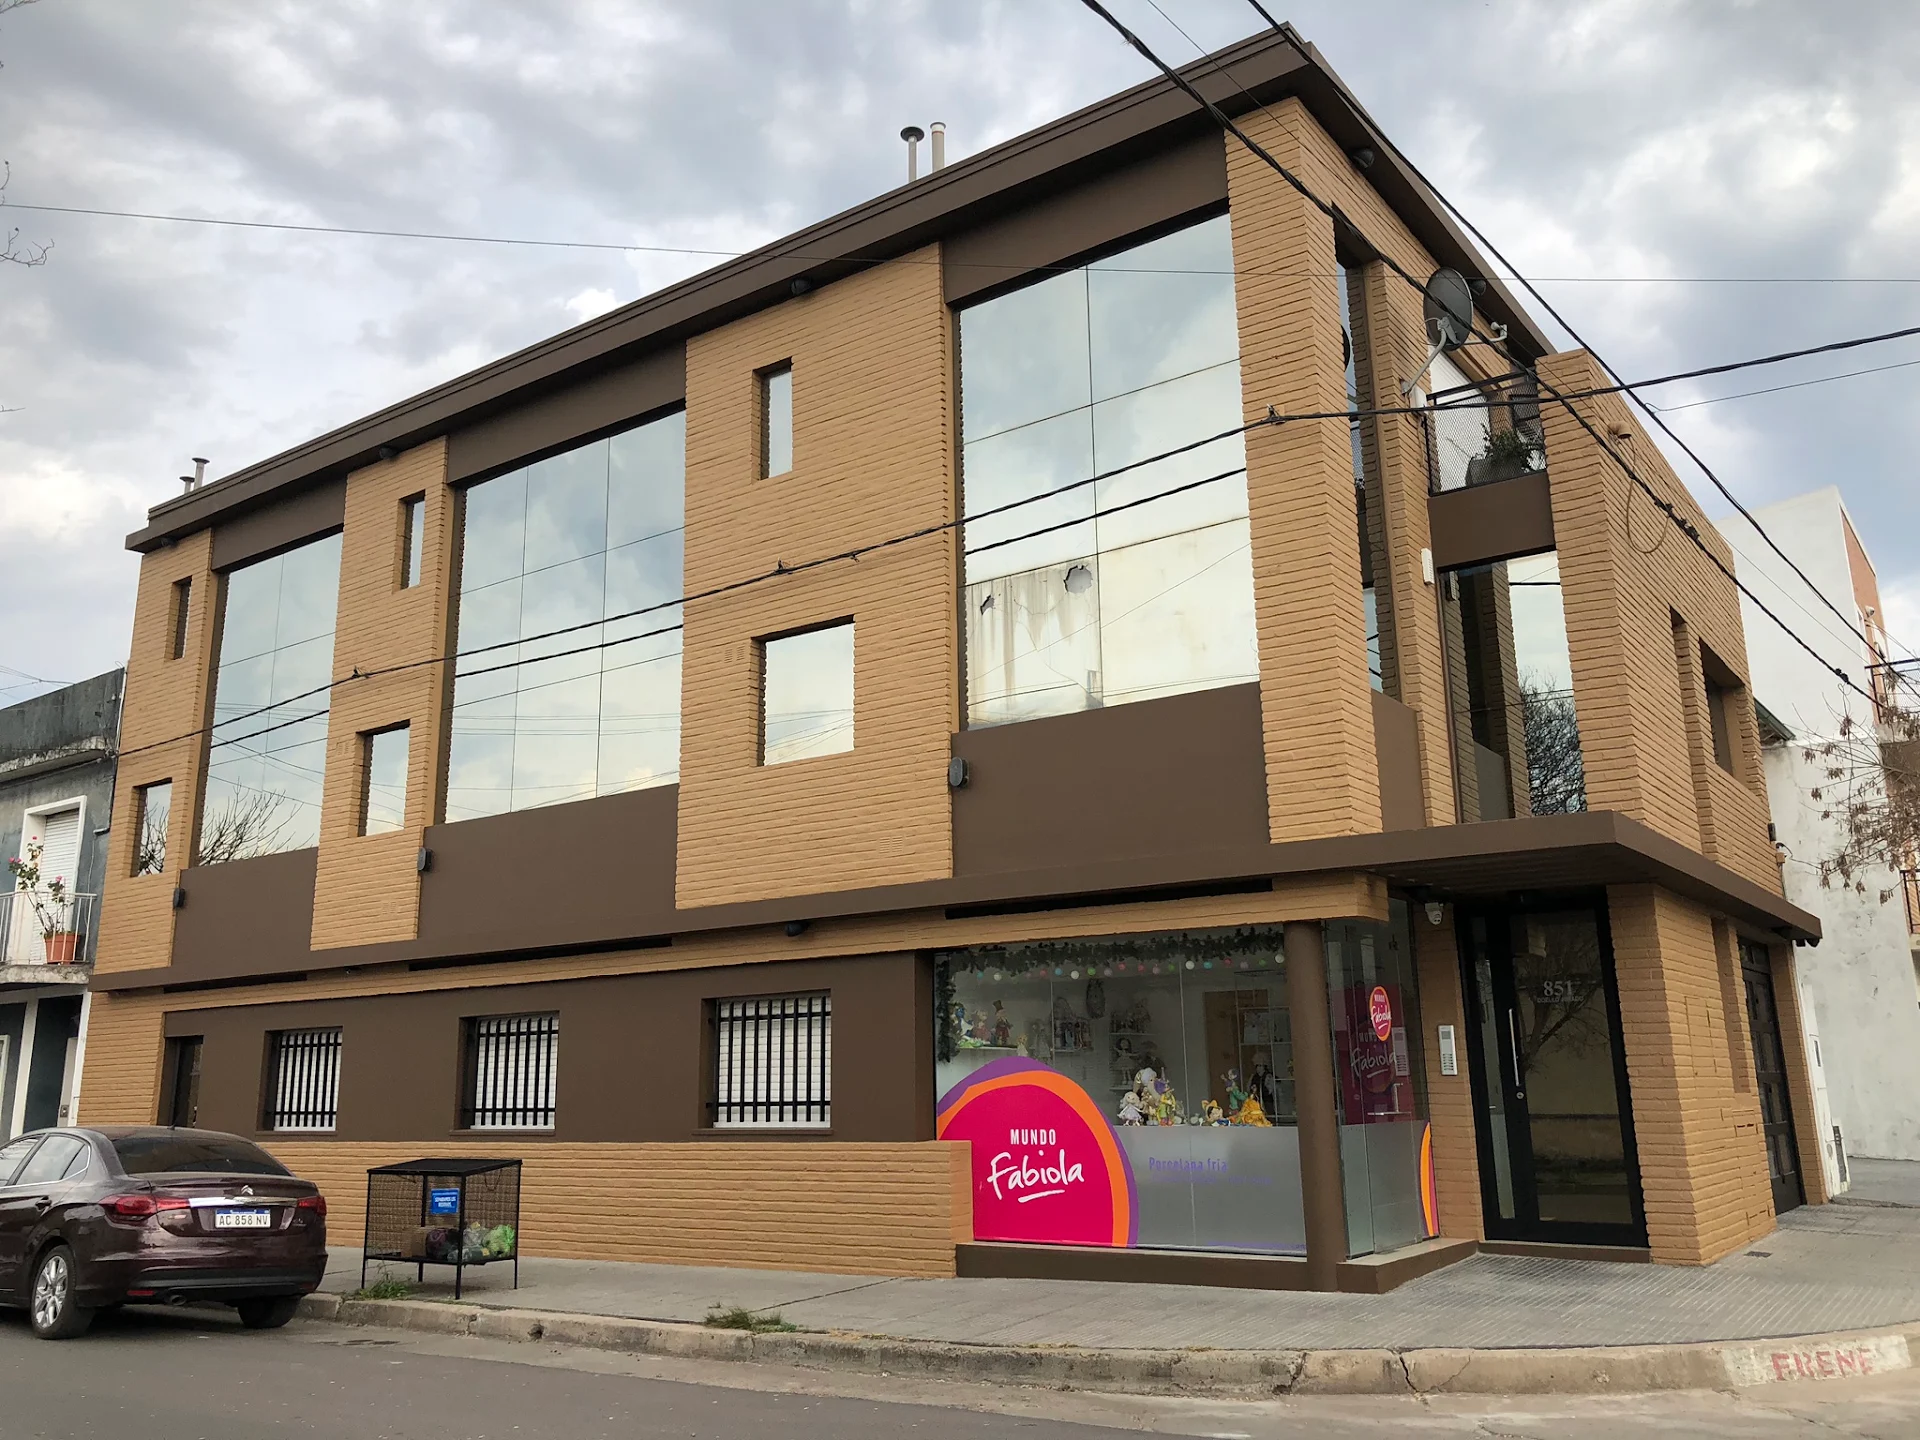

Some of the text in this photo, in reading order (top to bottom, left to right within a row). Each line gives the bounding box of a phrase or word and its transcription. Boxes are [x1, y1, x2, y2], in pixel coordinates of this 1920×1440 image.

[1543, 980, 1573, 997] 851
[1010, 1128, 1057, 1146] MUNDO
[987, 1148, 1085, 1201] Fabiola
[219, 1214, 268, 1226] AC 858 NV
